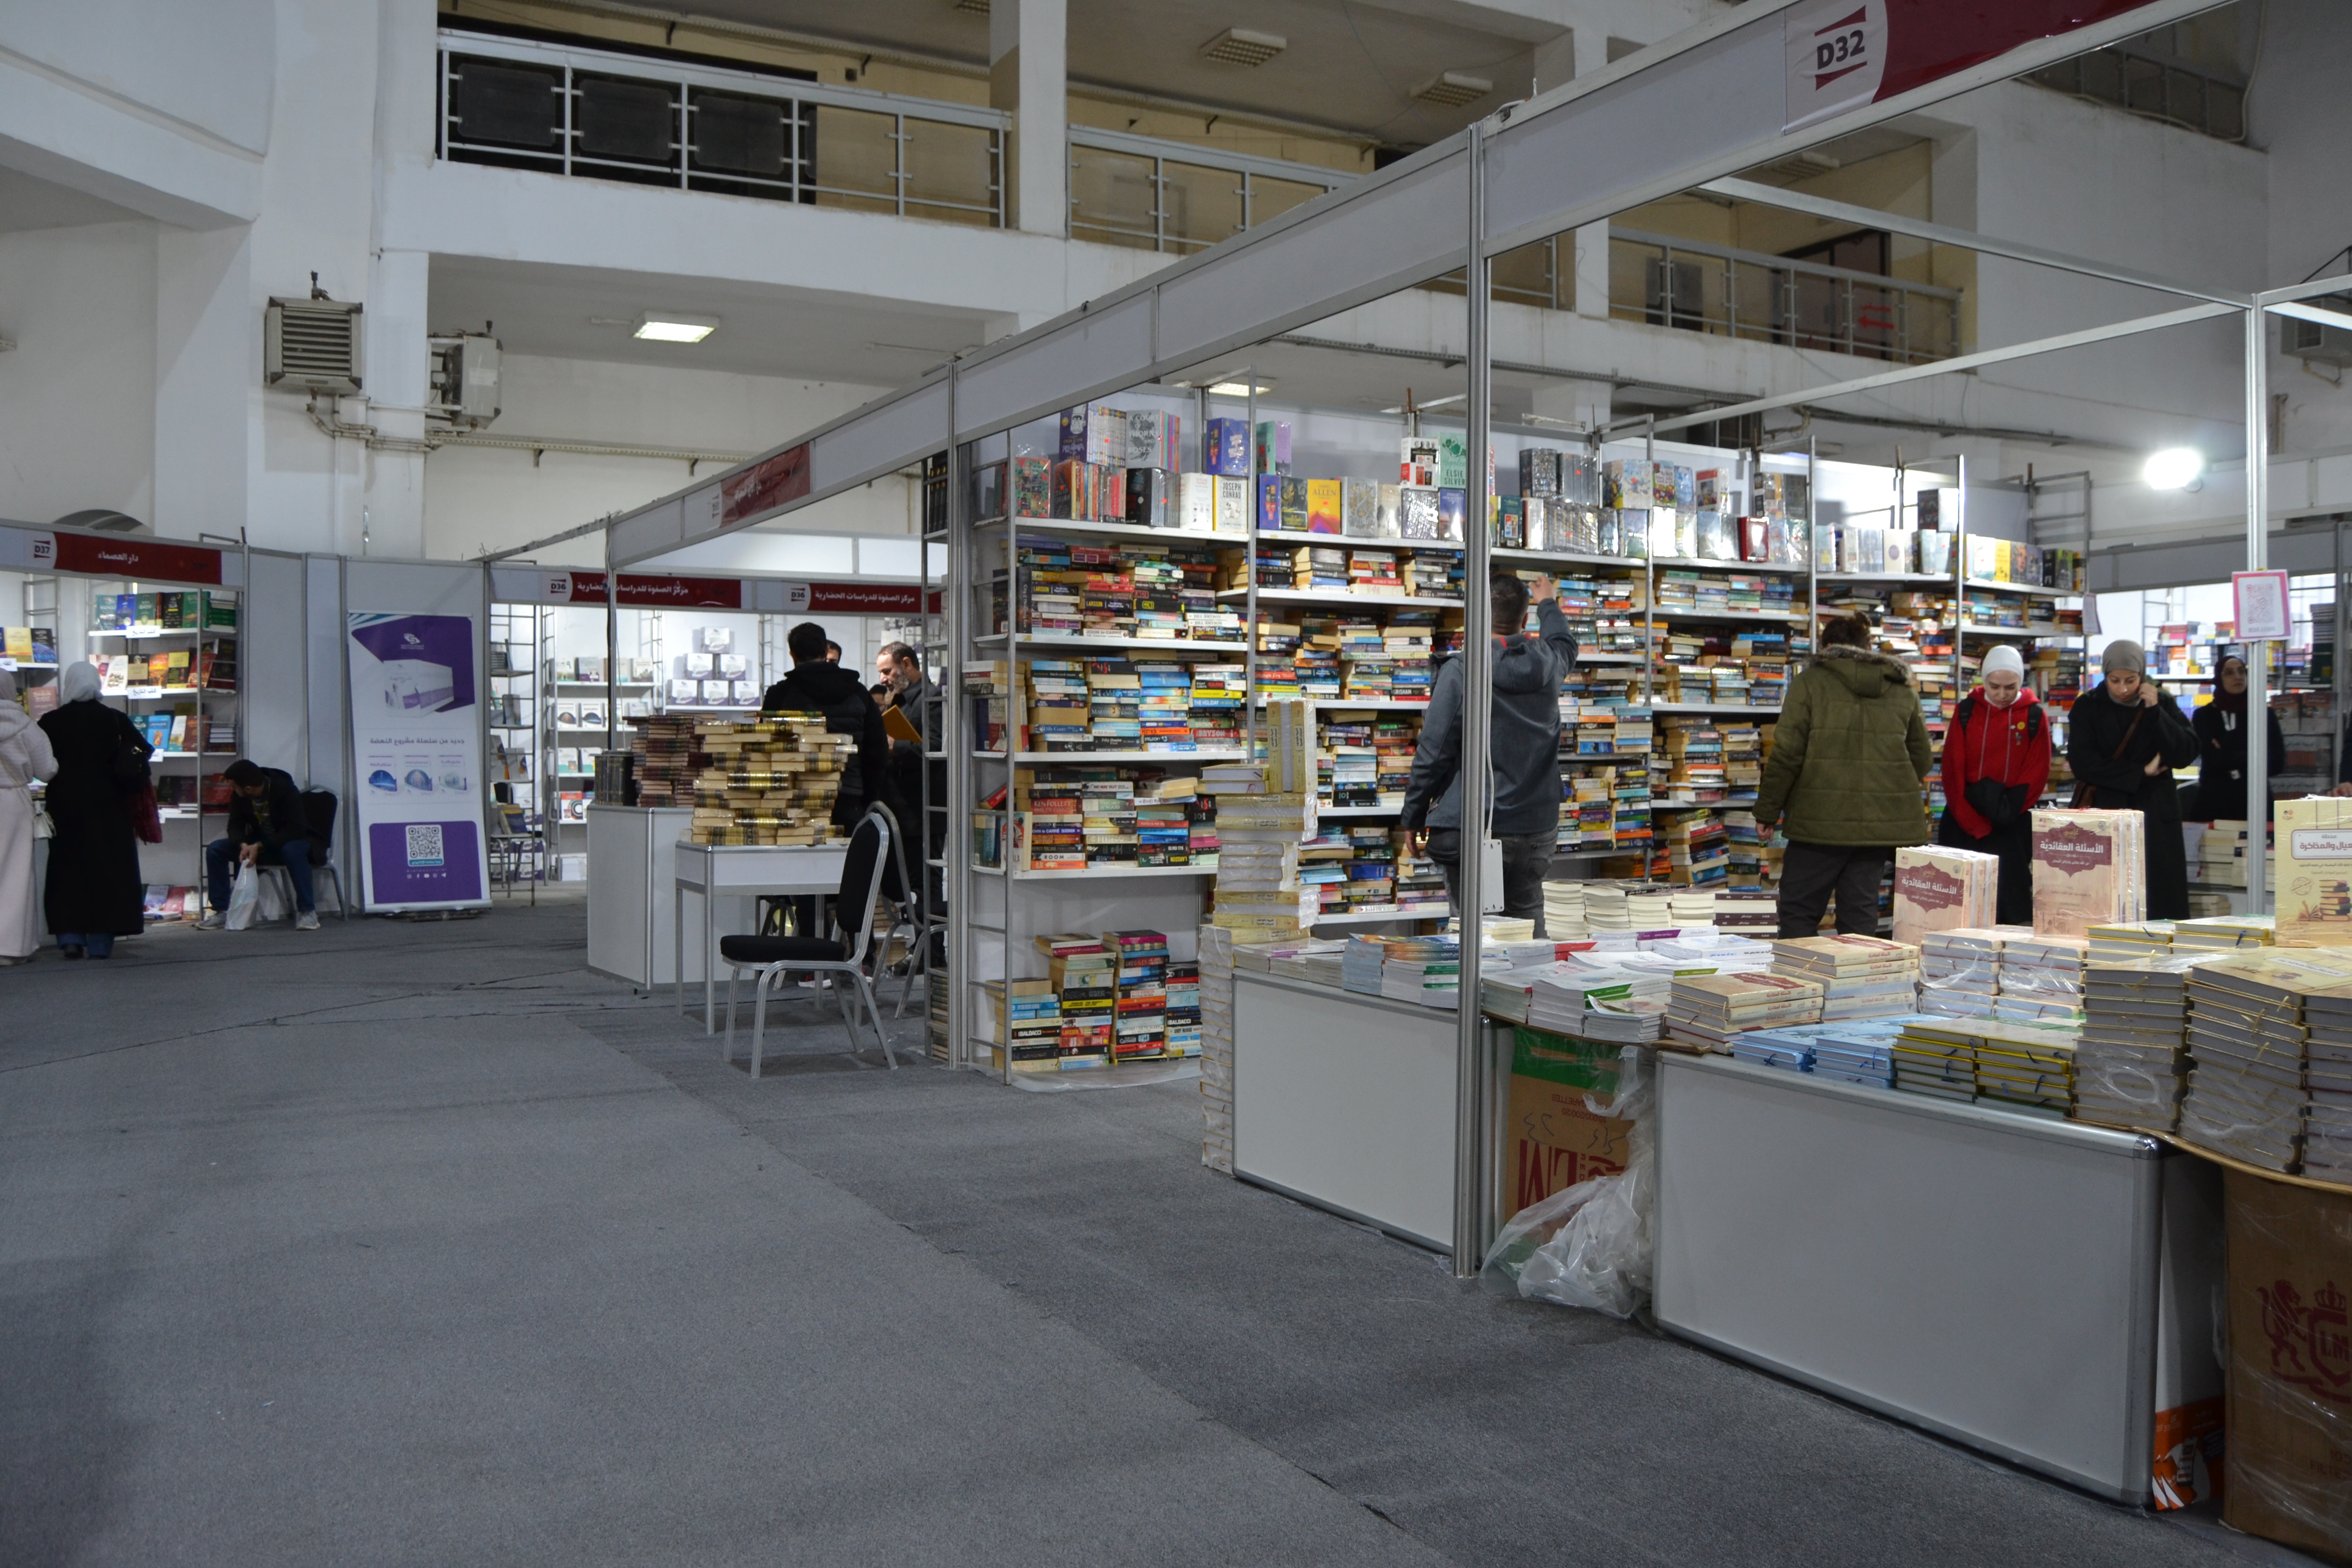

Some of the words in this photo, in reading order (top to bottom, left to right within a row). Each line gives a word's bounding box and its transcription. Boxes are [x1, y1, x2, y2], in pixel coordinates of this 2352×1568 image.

[1817, 30, 1865, 69] D32
[1446, 469, 1464, 477] ELSIE
[1444, 477, 1465, 485] SILVER
[1223, 482, 1241, 491] JOSEPH
[1223, 491, 1241, 499] CONRAD
[34, 546, 50, 554] D37
[128, 555, 139, 564] دار
[648, 585, 672, 595] الصفوة
[672, 585, 689, 596] مركز
[815, 592, 845, 601] الحضارية
[846, 593, 877, 602] للدراسات
[878, 594, 899, 603] الصفوة
[901, 595, 915, 603] مركز
[2075, 843, 2103, 853] الأسئلة
[1932, 882, 1957, 894] الأسئلة
[1552, 1094, 1586, 1107] GARETTES
